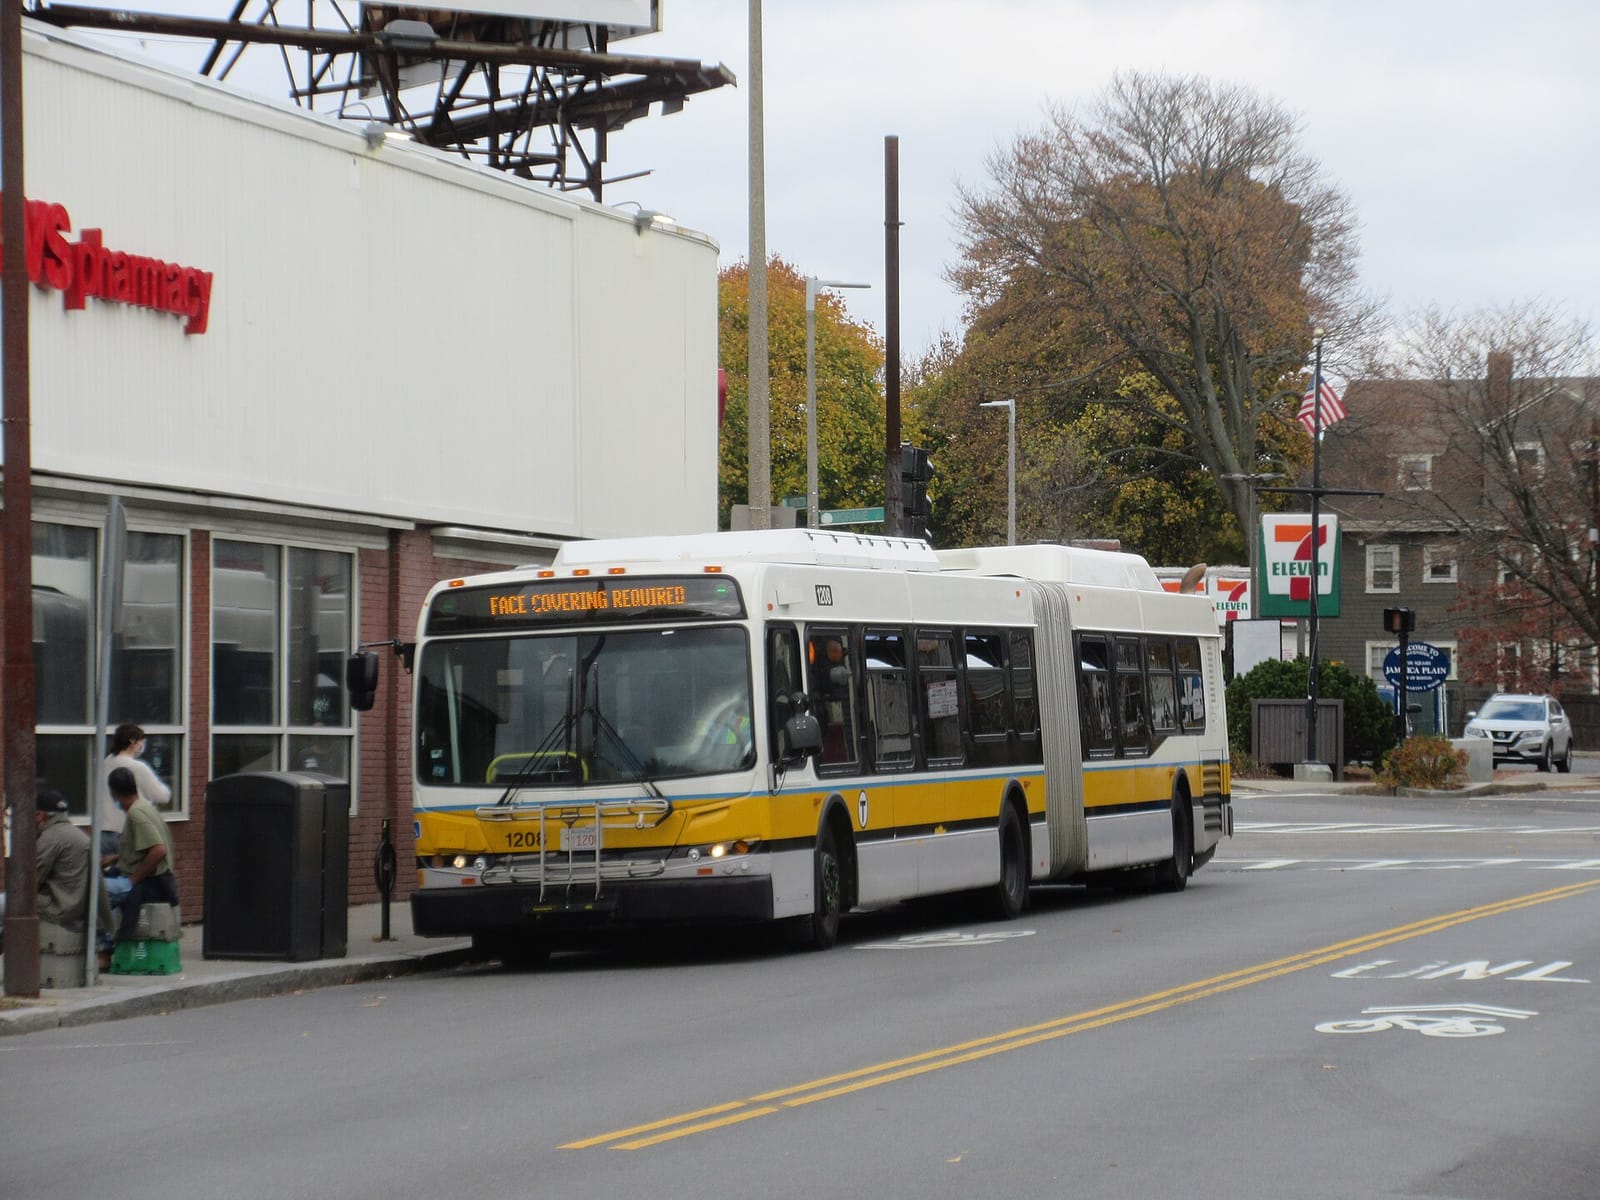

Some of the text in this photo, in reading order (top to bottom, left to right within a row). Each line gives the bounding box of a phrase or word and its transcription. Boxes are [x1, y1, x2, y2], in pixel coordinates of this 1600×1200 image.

[490, 586, 685, 616] FACE COVERING REQUIRED
[1385, 666, 1447, 675] JAMICA PLAIN
